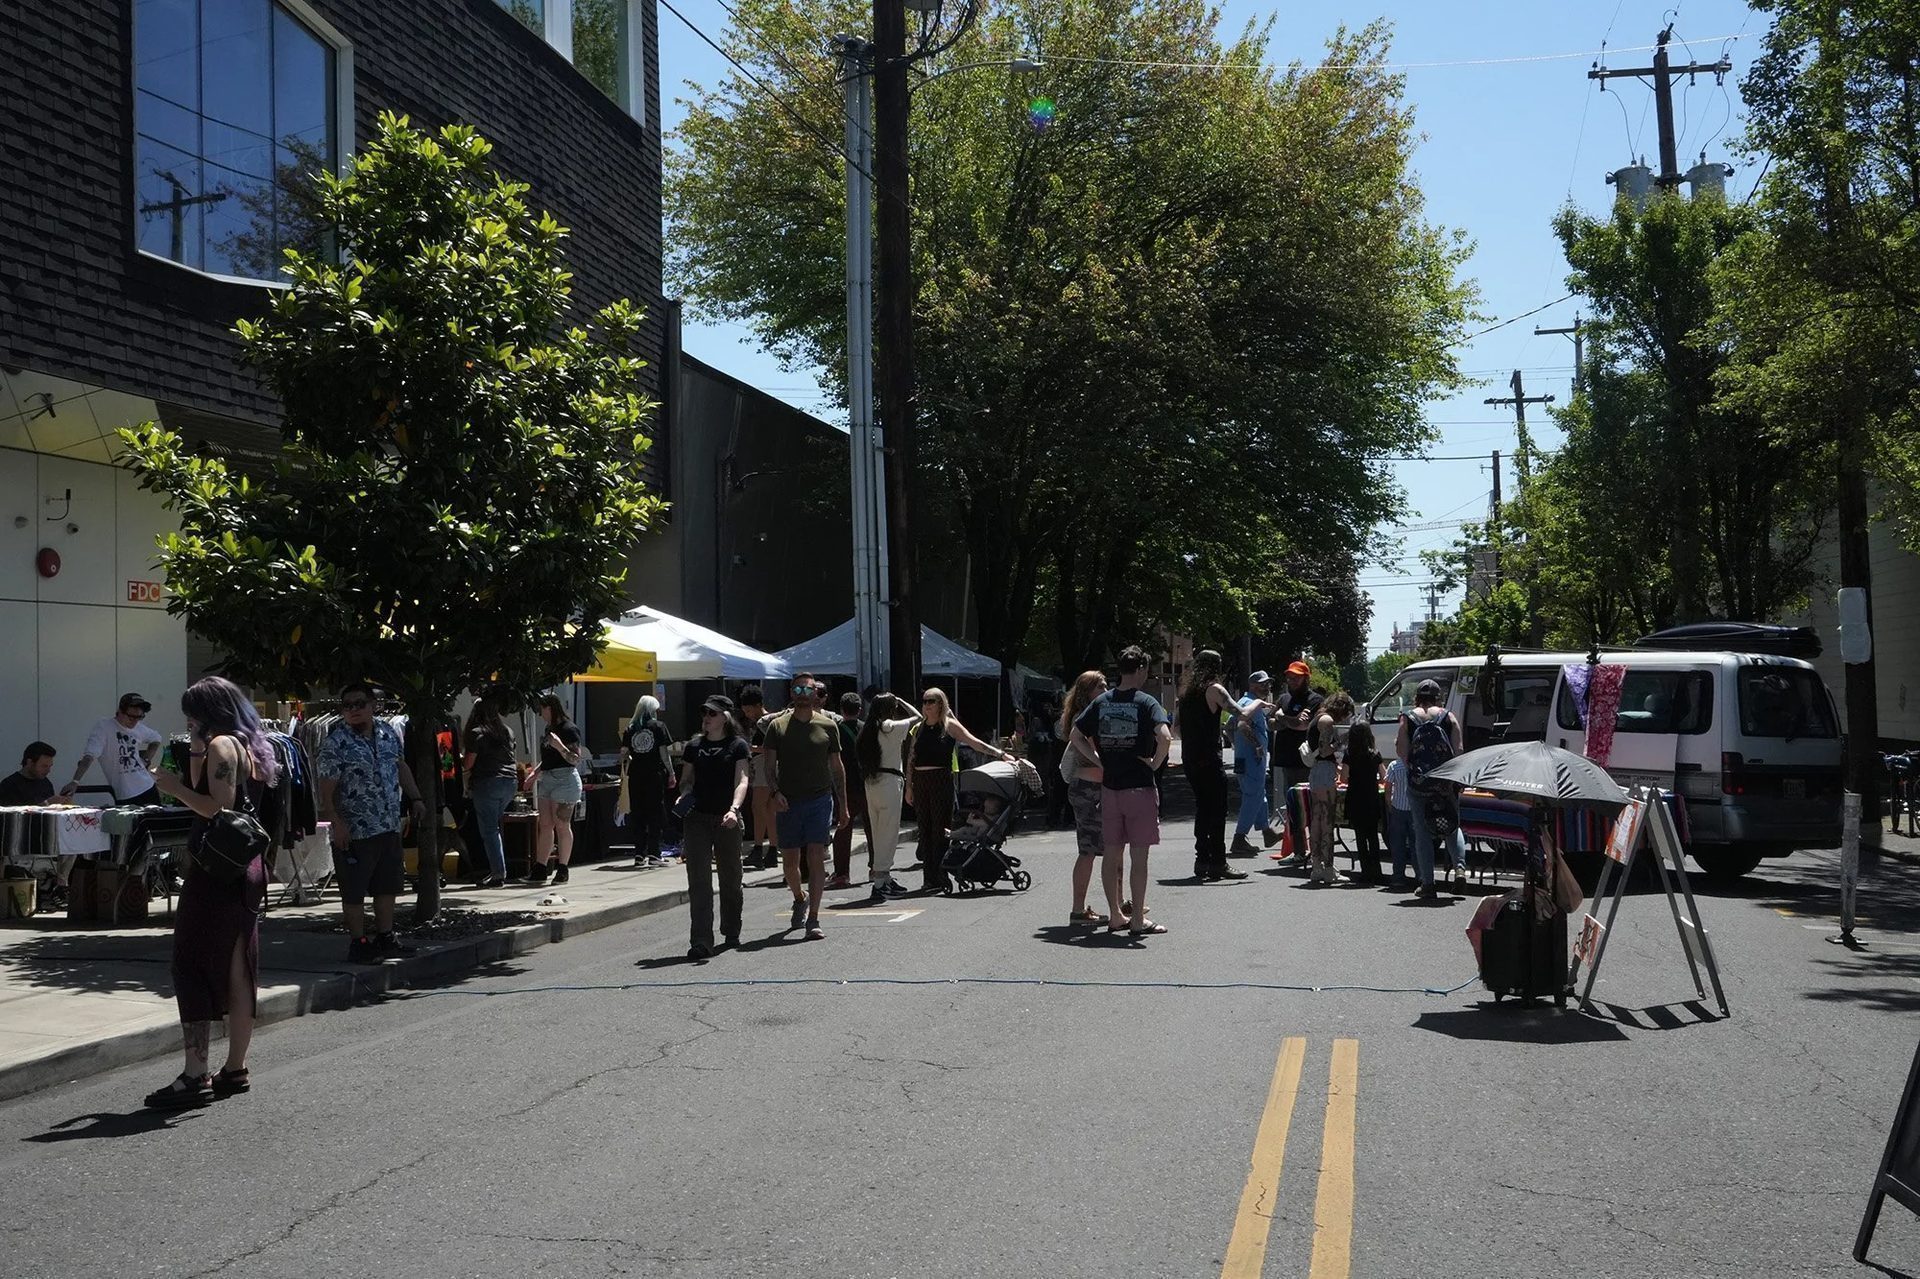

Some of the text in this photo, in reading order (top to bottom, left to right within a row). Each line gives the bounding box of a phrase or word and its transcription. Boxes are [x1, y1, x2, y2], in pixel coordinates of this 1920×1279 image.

[129, 582, 160, 601] FDC
[698, 747, 723, 757] N7
[1502, 779, 1544, 789] JUPITER
